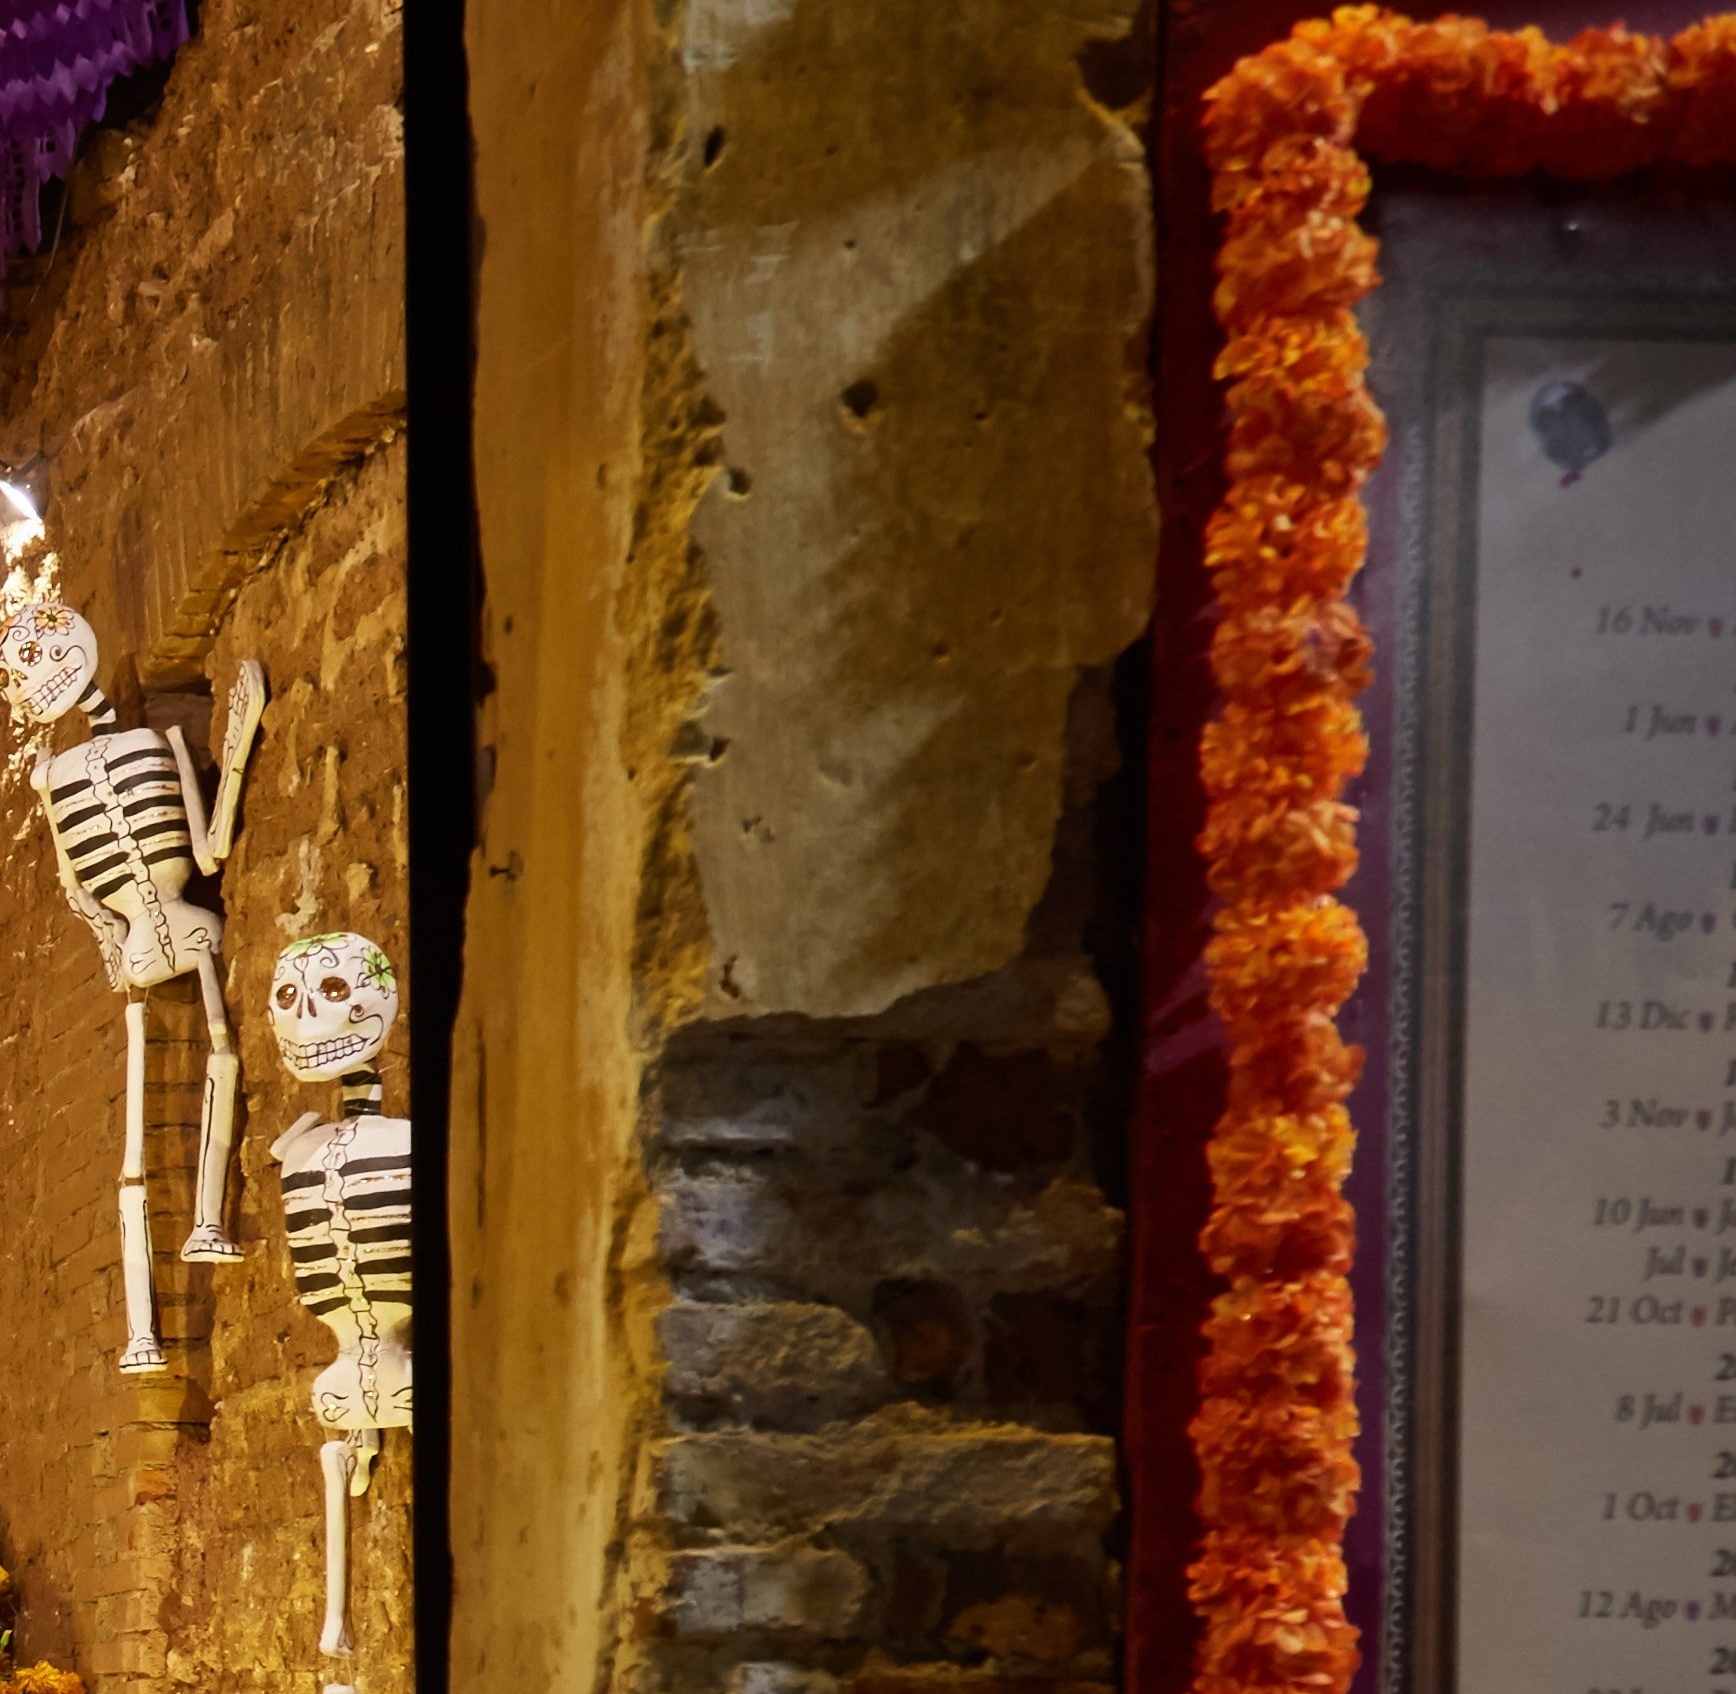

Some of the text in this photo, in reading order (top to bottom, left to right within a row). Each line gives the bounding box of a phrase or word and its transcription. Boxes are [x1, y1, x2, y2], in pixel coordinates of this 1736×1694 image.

[1596, 606, 1631, 634] 16
[1647, 704, 1697, 740] Jun
[1592, 803, 1631, 832] 24
[1644, 803, 1695, 839] Jun
[1634, 903, 1692, 942] Ago
[1596, 1000, 1631, 1030] 13
[1639, 999, 1690, 1031] Dic
[1600, 1099, 1620, 1129] 3
[1593, 1197, 1631, 1226] 10
[1635, 1197, 1685, 1233] Jun
[1643, 1245, 1686, 1282] Jul
[1585, 1294, 1683, 1325] 21 Oct
[1614, 1393, 1635, 1423] 8
[1639, 1392, 1682, 1430] Jul
[1603, 1492, 1617, 1521] 1
[1626, 1491, 1679, 1523] Oct
[1577, 1590, 1614, 1619] 12
[1619, 1590, 1678, 1630] Ago
